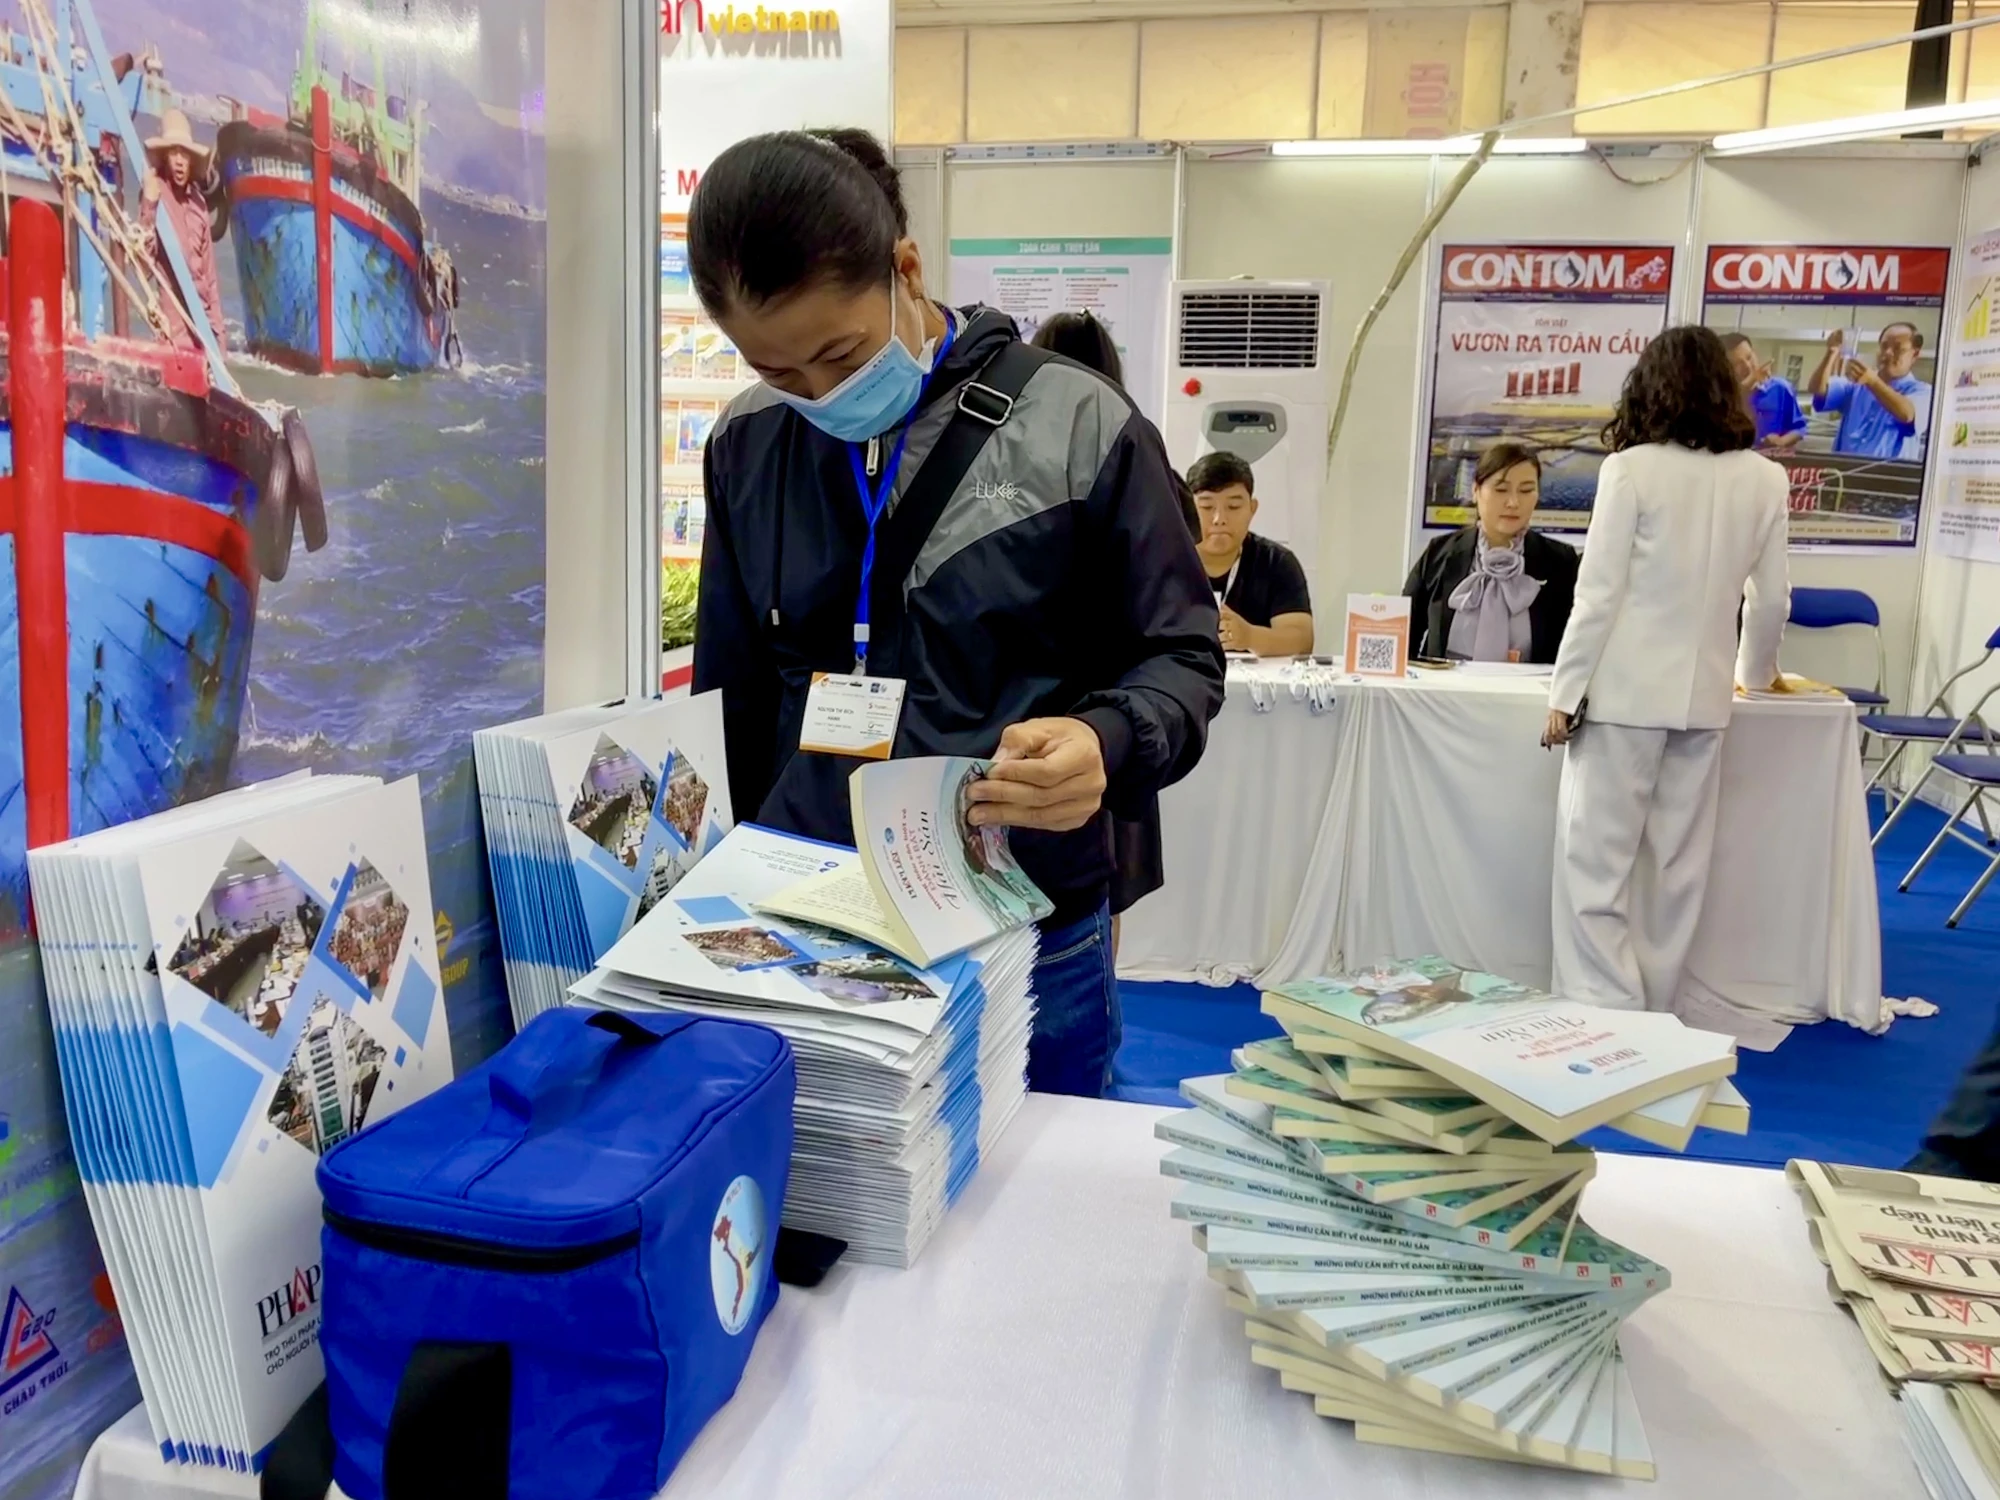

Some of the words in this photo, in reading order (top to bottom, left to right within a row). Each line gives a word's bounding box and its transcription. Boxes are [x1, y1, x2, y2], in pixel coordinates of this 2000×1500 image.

[708, 4, 839, 36] vietnam
[1451, 332, 1509, 352] VƯƠN
[1517, 335, 1542, 353] RA
[1548, 330, 1602, 354] TOÀN
[1880, 1205, 1933, 1224] tiếp
[1912, 1224, 1981, 1244] Ninh
[266, 1357, 284, 1375] CHO
